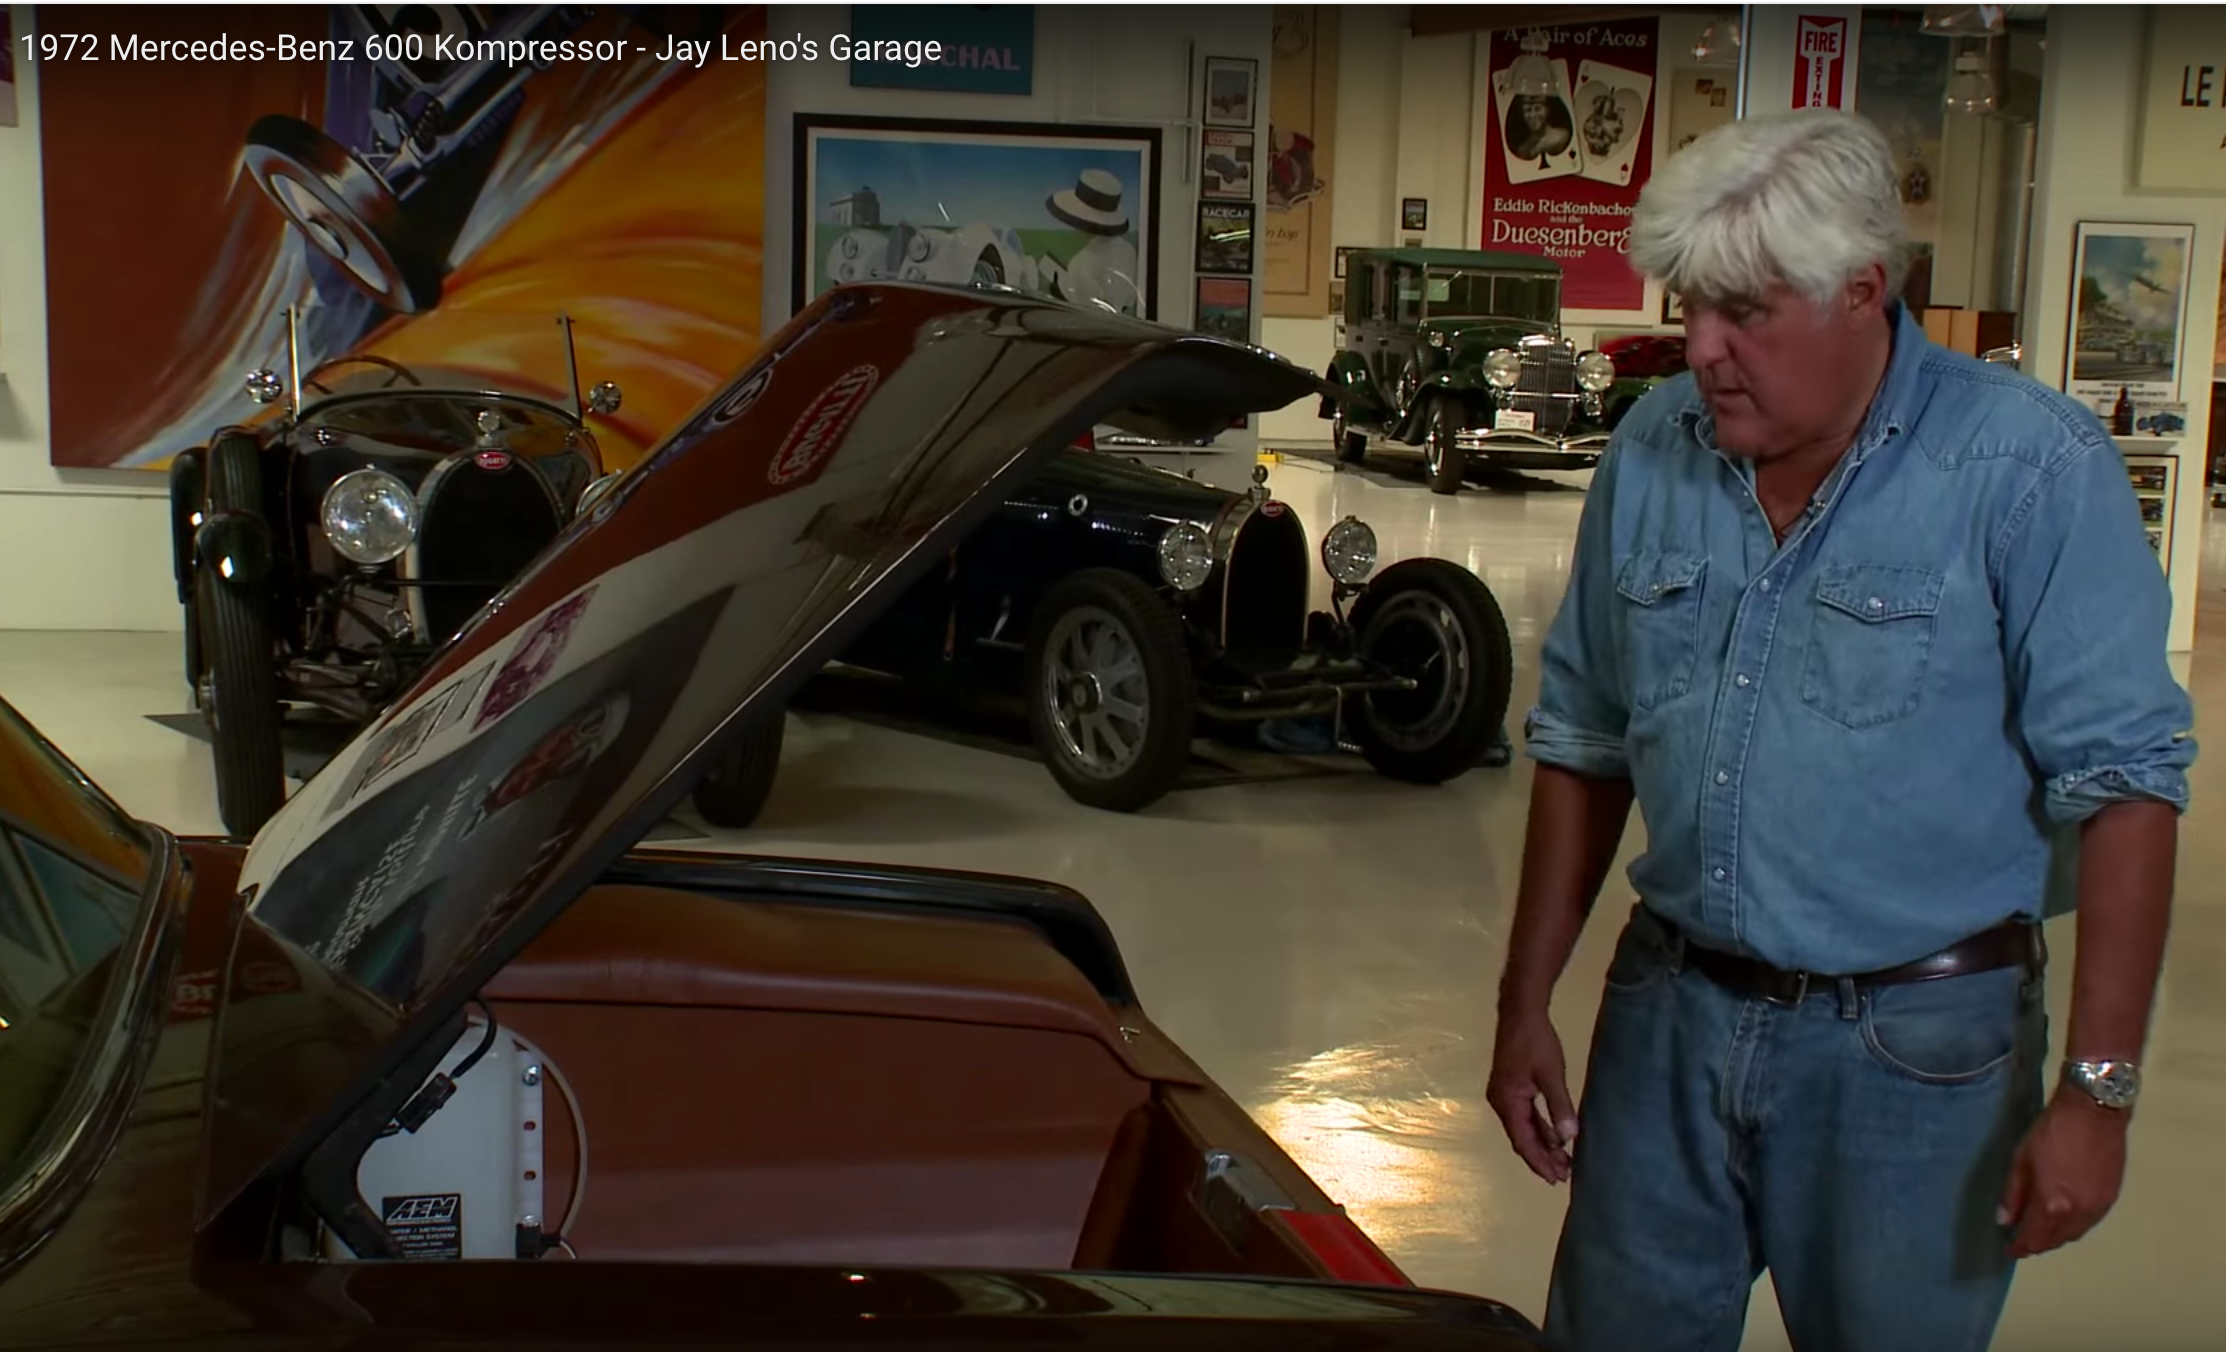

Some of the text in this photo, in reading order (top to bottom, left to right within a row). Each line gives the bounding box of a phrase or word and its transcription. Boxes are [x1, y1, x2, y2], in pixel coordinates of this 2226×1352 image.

[1502, 27, 1649, 48] A air of Aces
[1805, 31, 1838, 53] FIRE
[2181, 65, 2214, 107] LE
[1493, 197, 1535, 213] Eddie
[1276, 226, 1299, 241] top
[1491, 219, 1632, 254] Duesenberg
[1543, 245, 1586, 258] Motor
[387, 1196, 459, 1220] AEM
